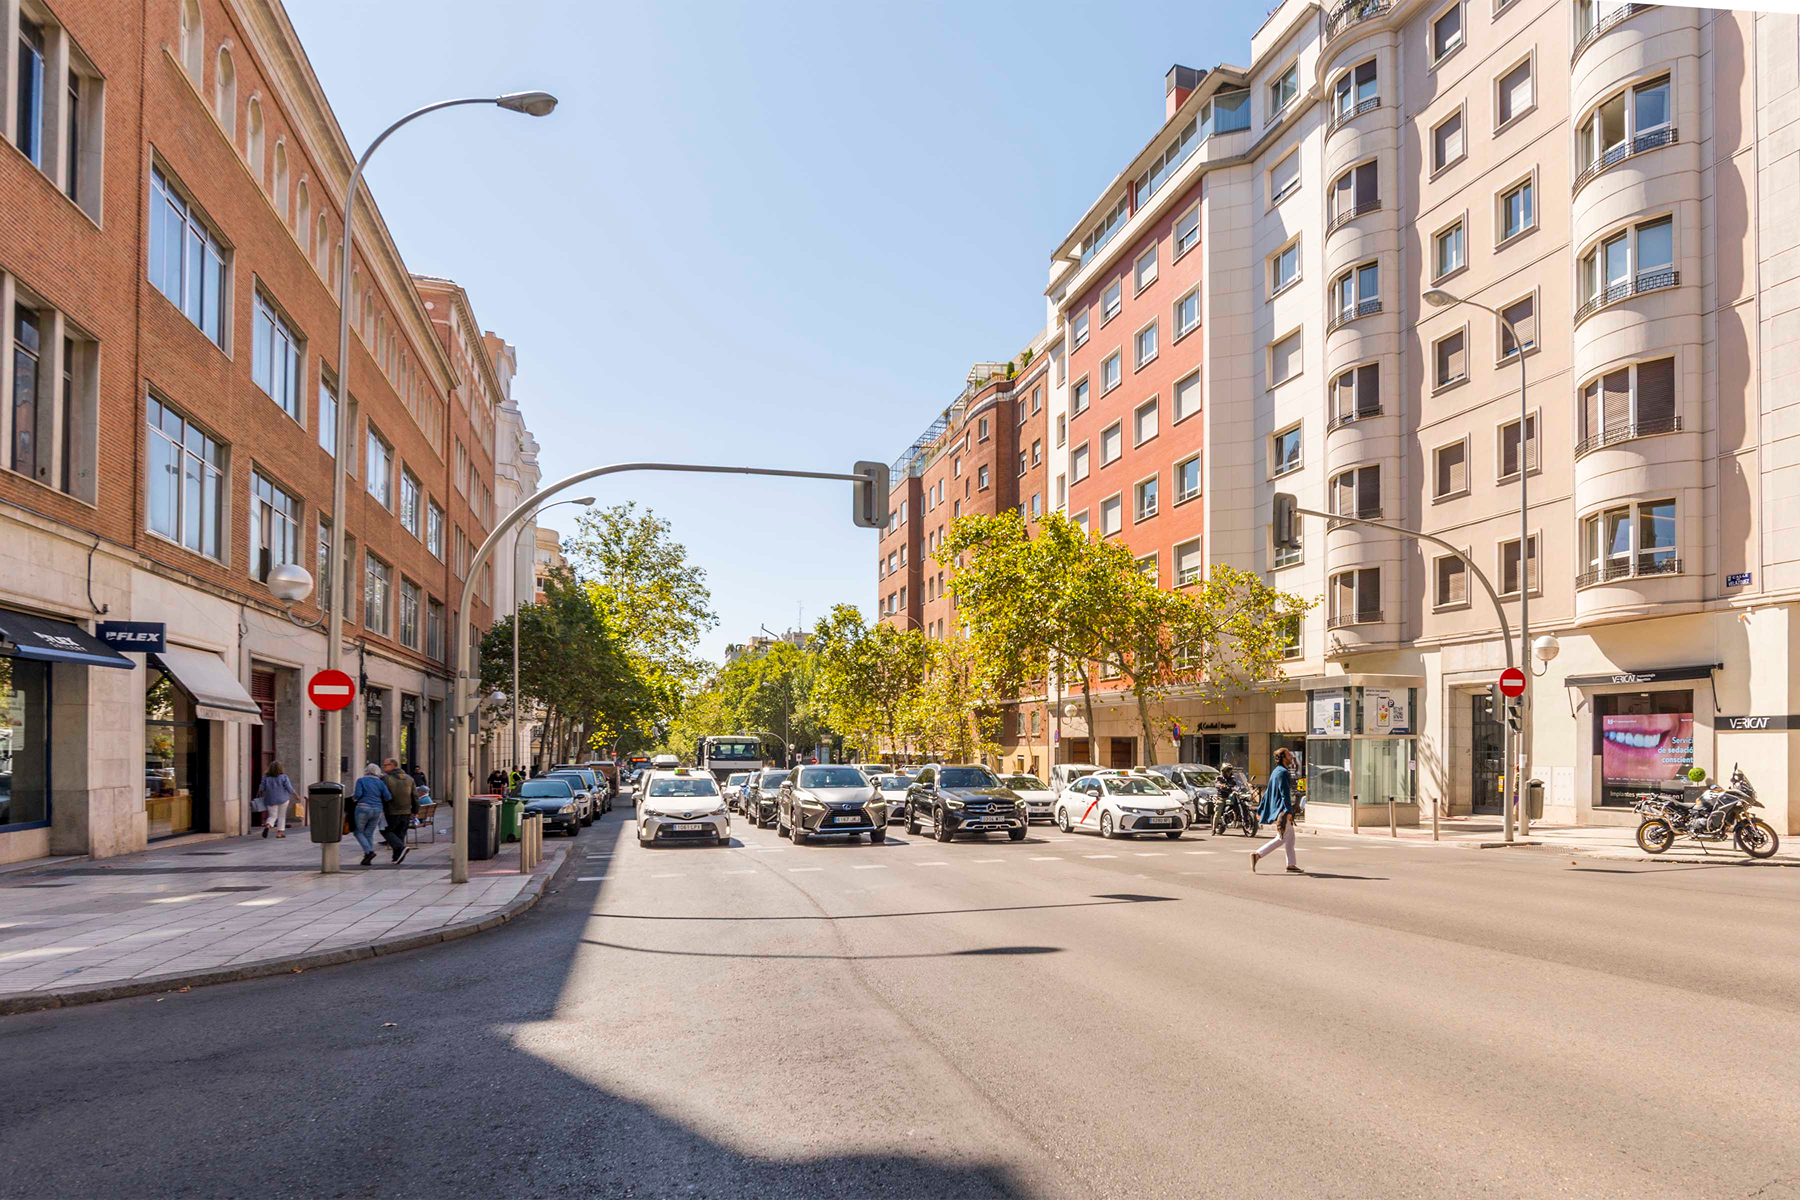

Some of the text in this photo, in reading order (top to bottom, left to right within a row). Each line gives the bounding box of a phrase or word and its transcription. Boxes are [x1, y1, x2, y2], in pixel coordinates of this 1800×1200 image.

[1612, 674, 1636, 684] VERICAT
[1729, 717, 1770, 729] VERICAT
[1658, 746, 1666, 754] de
[1610, 790, 1635, 799] Implantes
